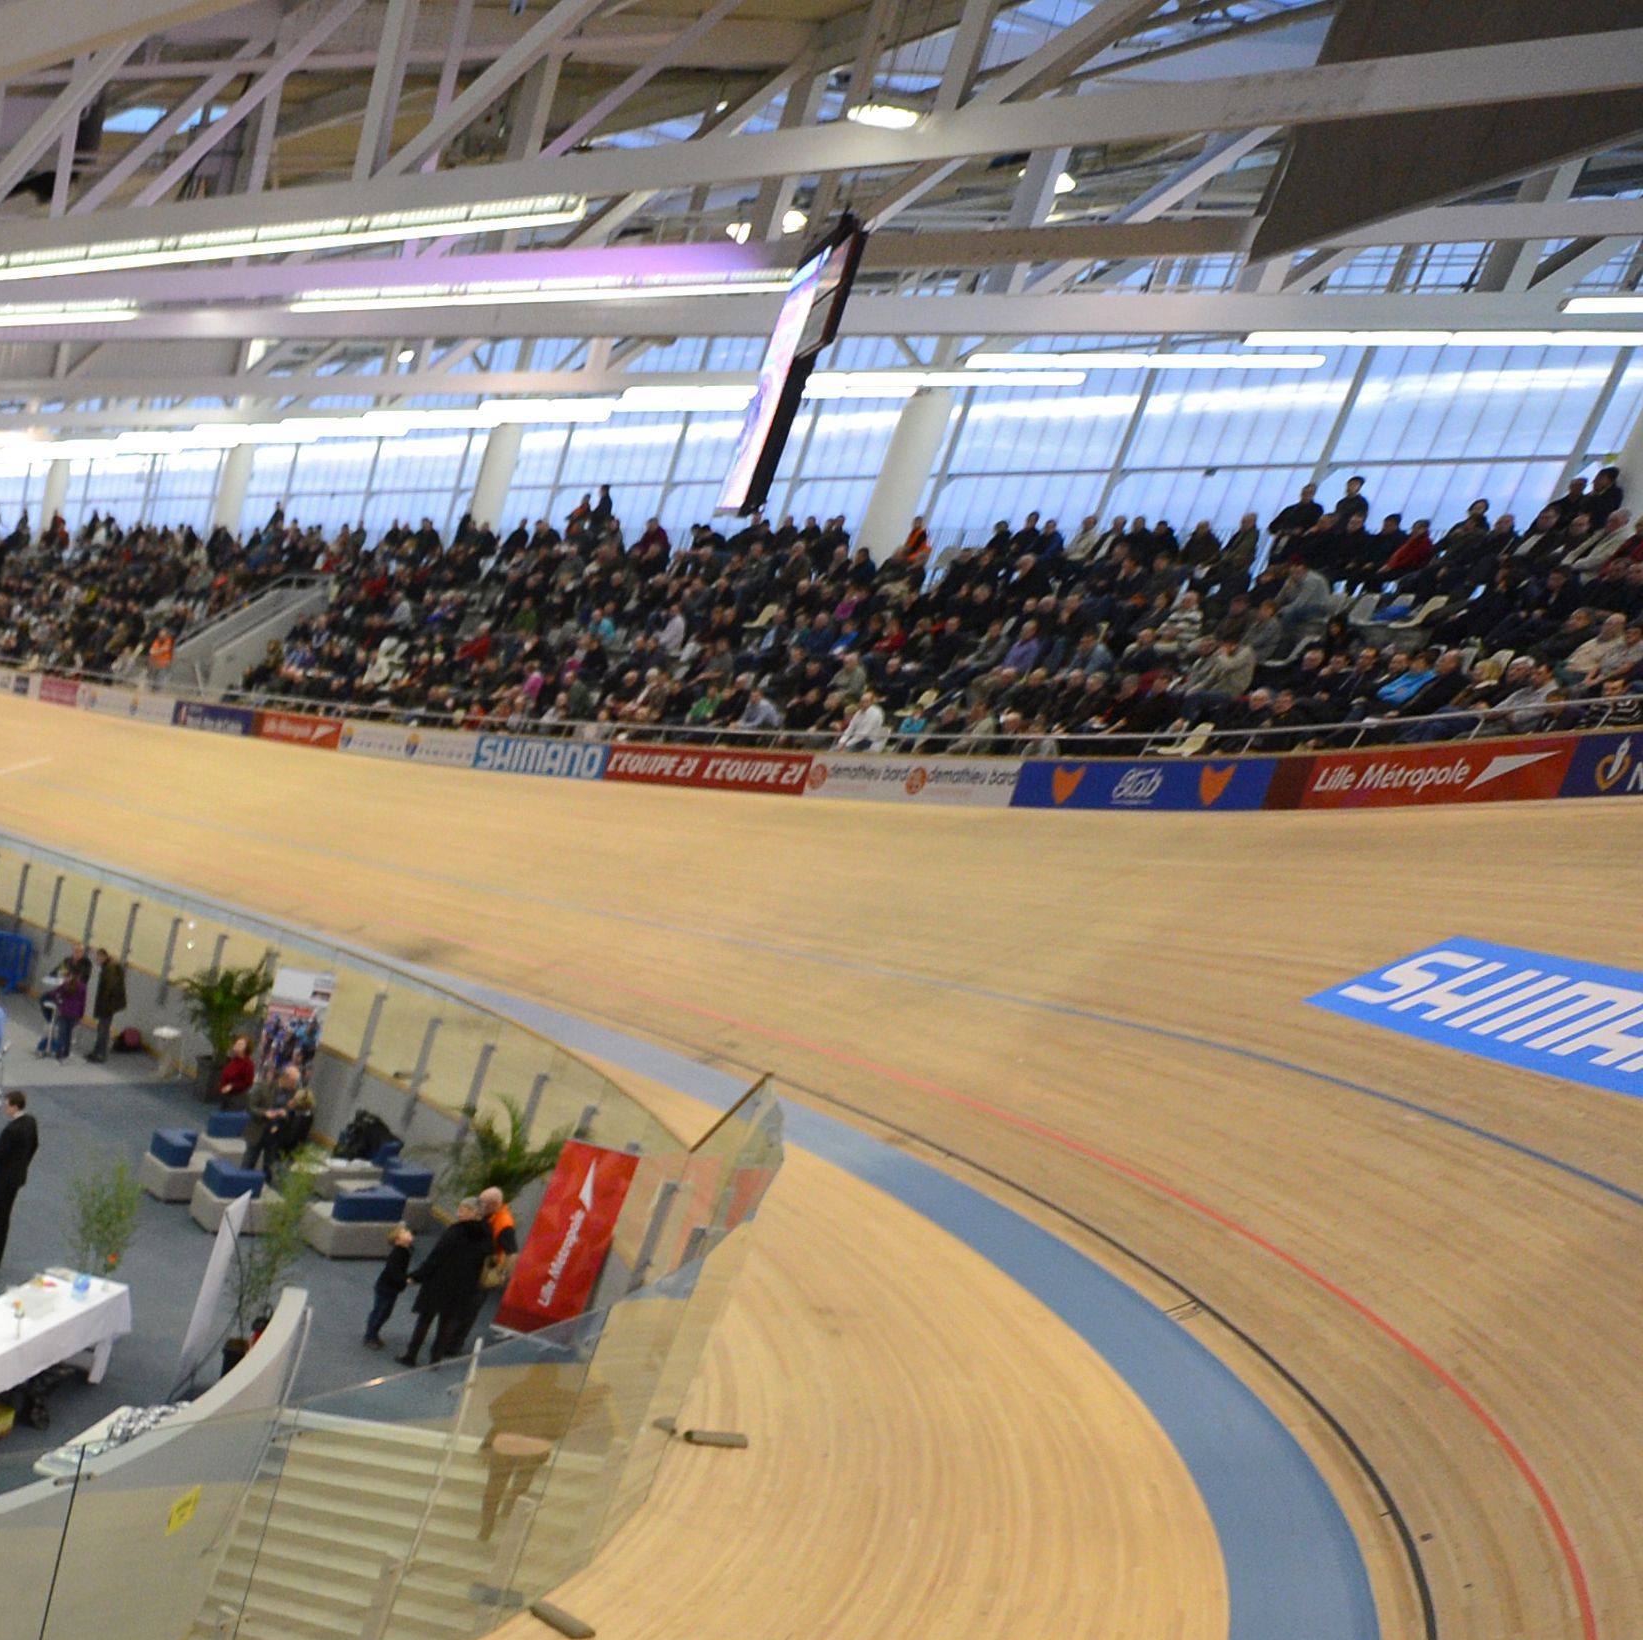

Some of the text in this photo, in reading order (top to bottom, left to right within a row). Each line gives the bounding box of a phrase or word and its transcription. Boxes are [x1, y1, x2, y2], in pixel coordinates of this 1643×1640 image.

[477, 737, 601, 779] SHIMANO
[675, 756, 700, 778] 21
[780, 763, 807, 785] 21
[1312, 757, 1472, 795] Lille Métropole
[1337, 950, 1643, 1073] SHIMA
[537, 1279, 557, 1308] Lille
